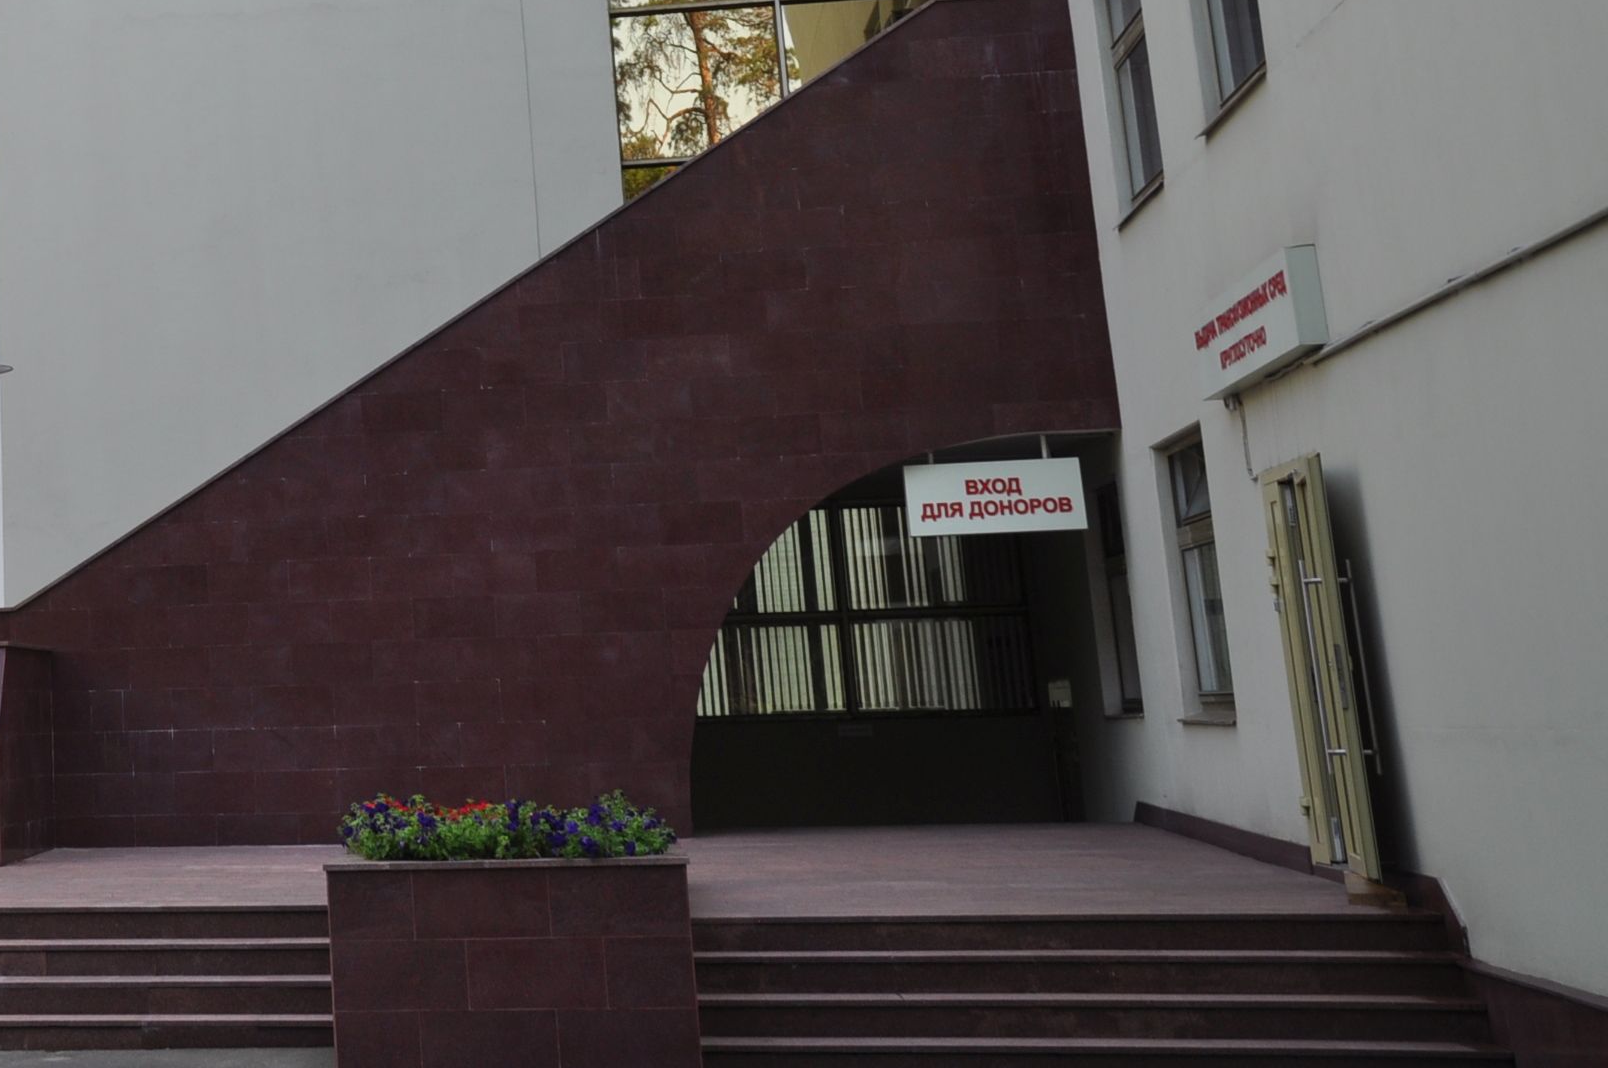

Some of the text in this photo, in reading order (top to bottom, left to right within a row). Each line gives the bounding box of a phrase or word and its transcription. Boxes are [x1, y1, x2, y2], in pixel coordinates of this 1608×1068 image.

[964, 477, 1023, 496] ВХОД
[920, 496, 1074, 522] ДЛЯ ДОНОРОВ
